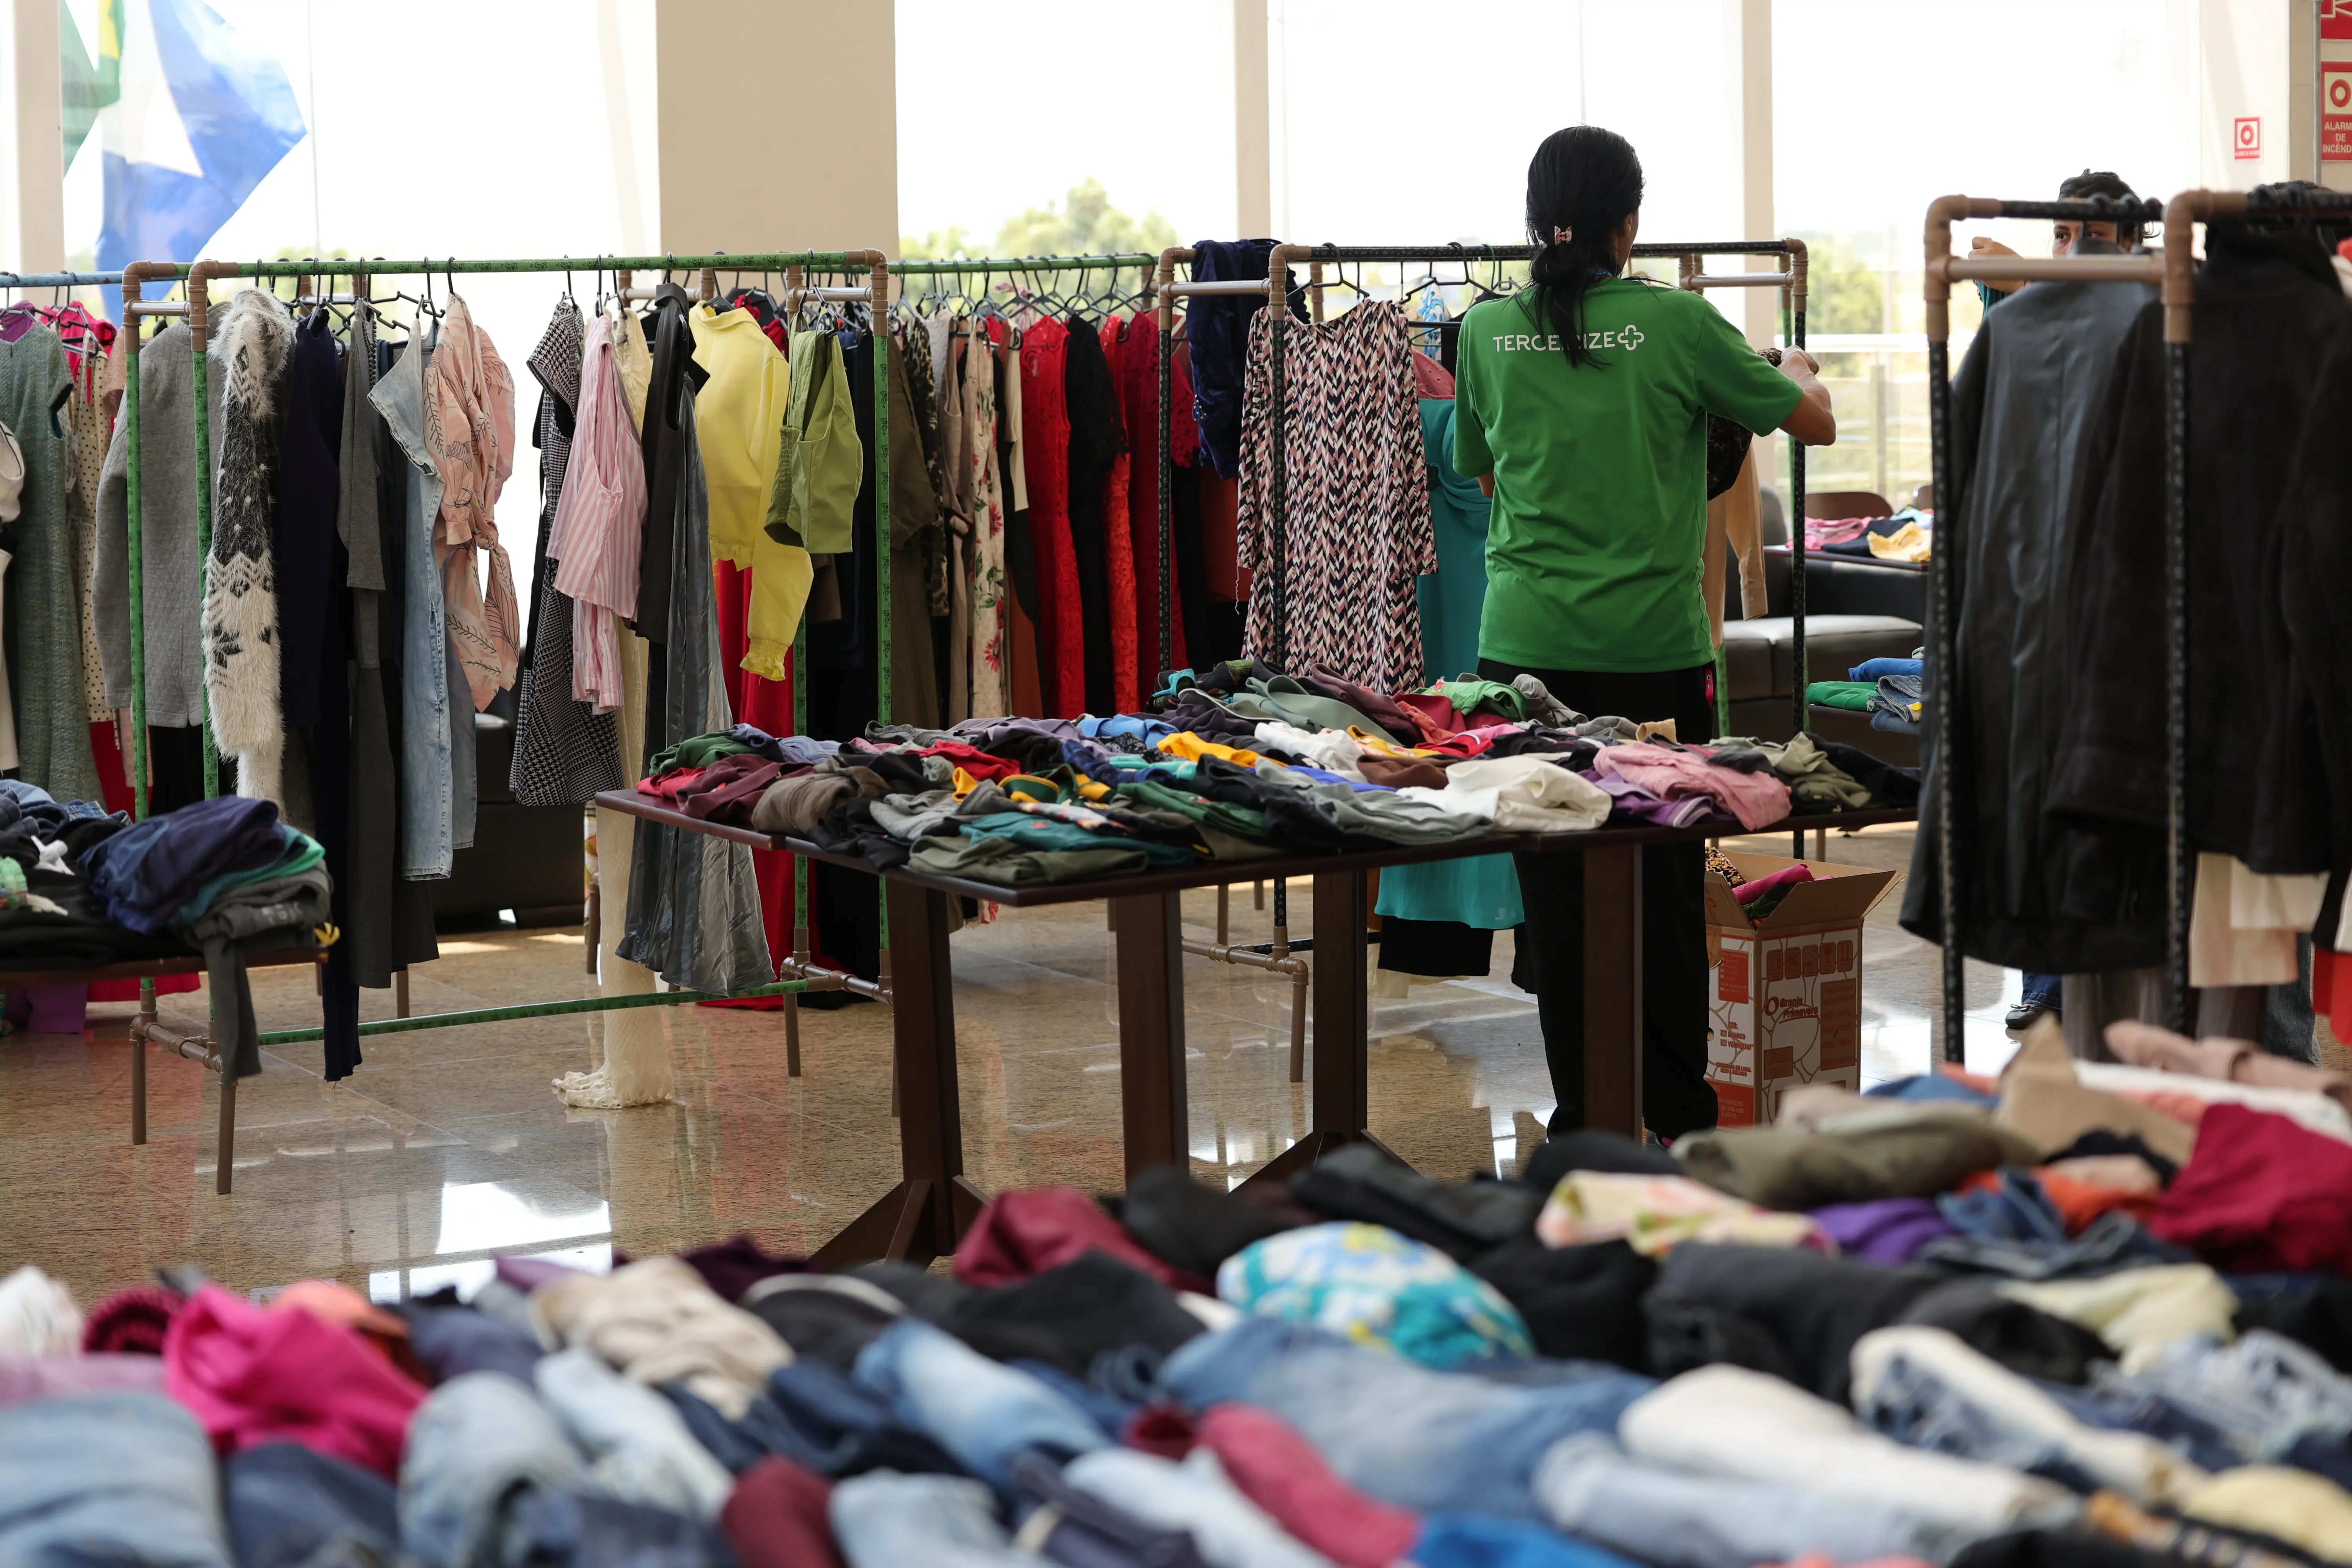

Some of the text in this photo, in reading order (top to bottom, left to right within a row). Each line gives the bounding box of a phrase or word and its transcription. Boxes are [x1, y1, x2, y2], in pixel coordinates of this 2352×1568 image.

[2336, 133, 2346, 142] DE
[1493, 331, 1615, 352] TERCEIZE
[1728, 1032, 1746, 1040] BRANCO
[1728, 1040, 1751, 1051] VERMELHO
